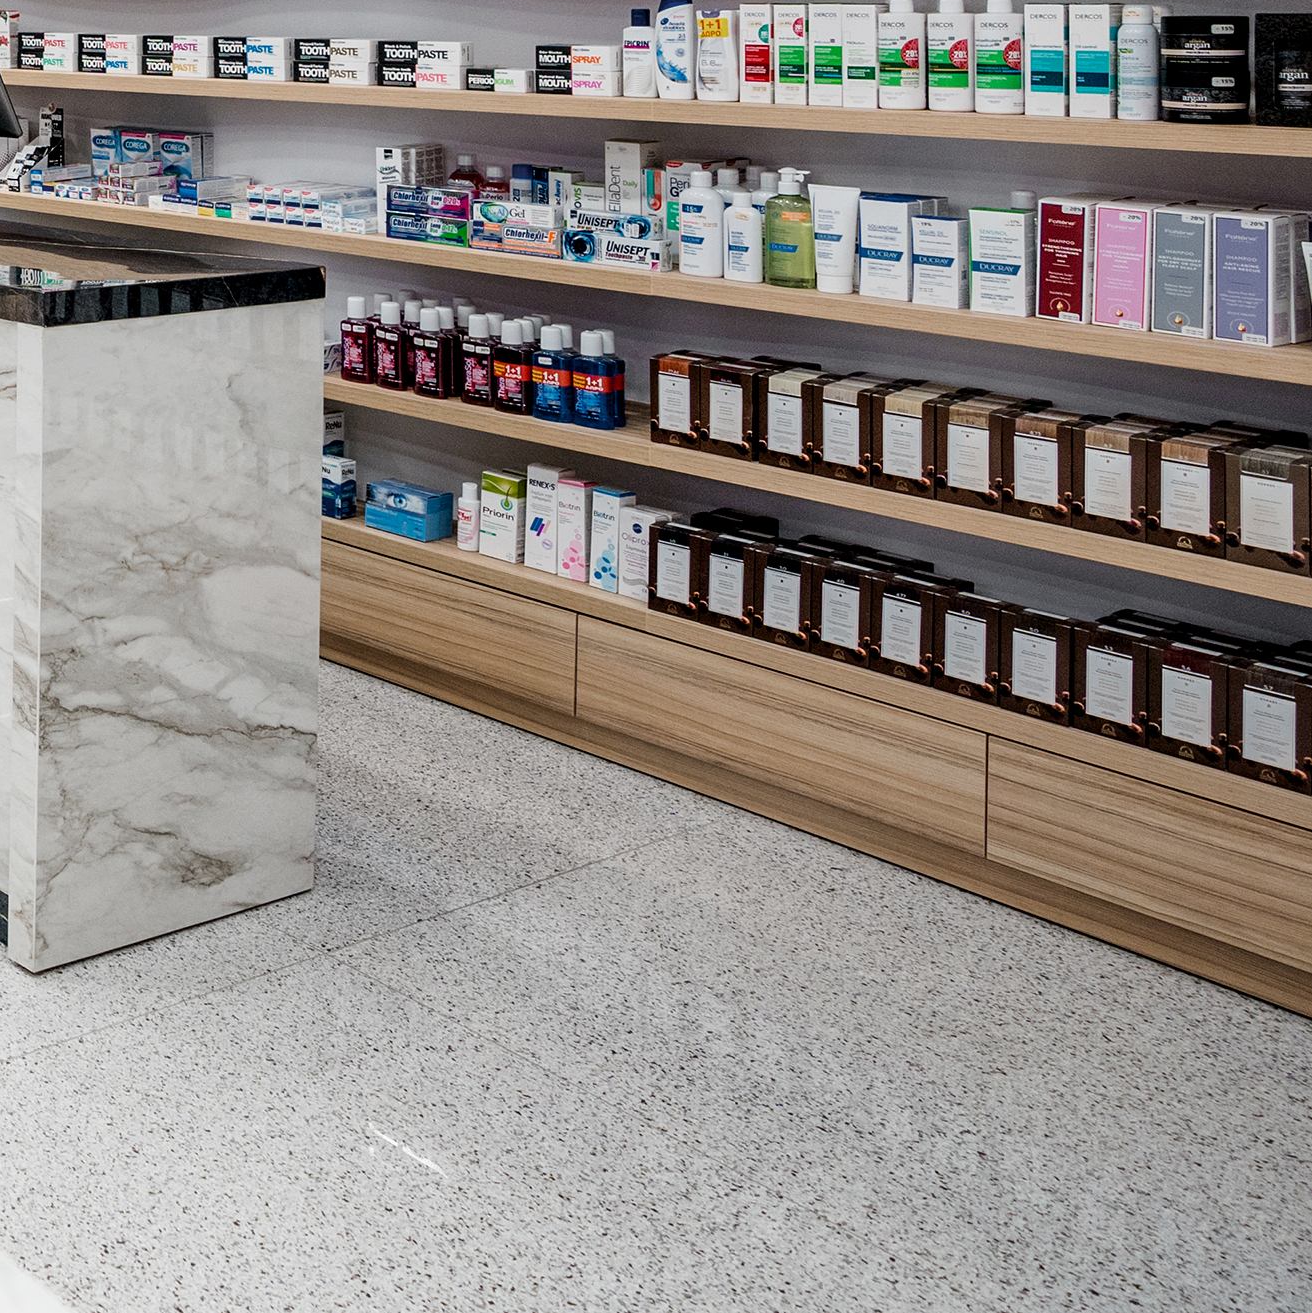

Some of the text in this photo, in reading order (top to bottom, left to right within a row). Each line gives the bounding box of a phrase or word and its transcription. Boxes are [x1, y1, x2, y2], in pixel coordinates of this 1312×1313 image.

[699, 19, 721, 31] 1+1
[624, 40, 650, 49] EPICRIN
[1185, 42, 1210, 51] argan
[509, 209, 526, 219] Gel
[577, 214, 619, 228] UNISEPT
[606, 242, 650, 256] UNISEPT
[867, 250, 898, 259] DUCRAY
[919, 257, 949, 266] DUCRAY
[980, 264, 1014, 273] DUCRAY
[506, 366, 521, 375] 1+1
[543, 372, 558, 381] 1+1
[586, 378, 603, 387] 1+1
[558, 501, 581, 511] Biotrin
[483, 506, 513, 521] Priorin
[593, 510, 615, 521] Biotrin
